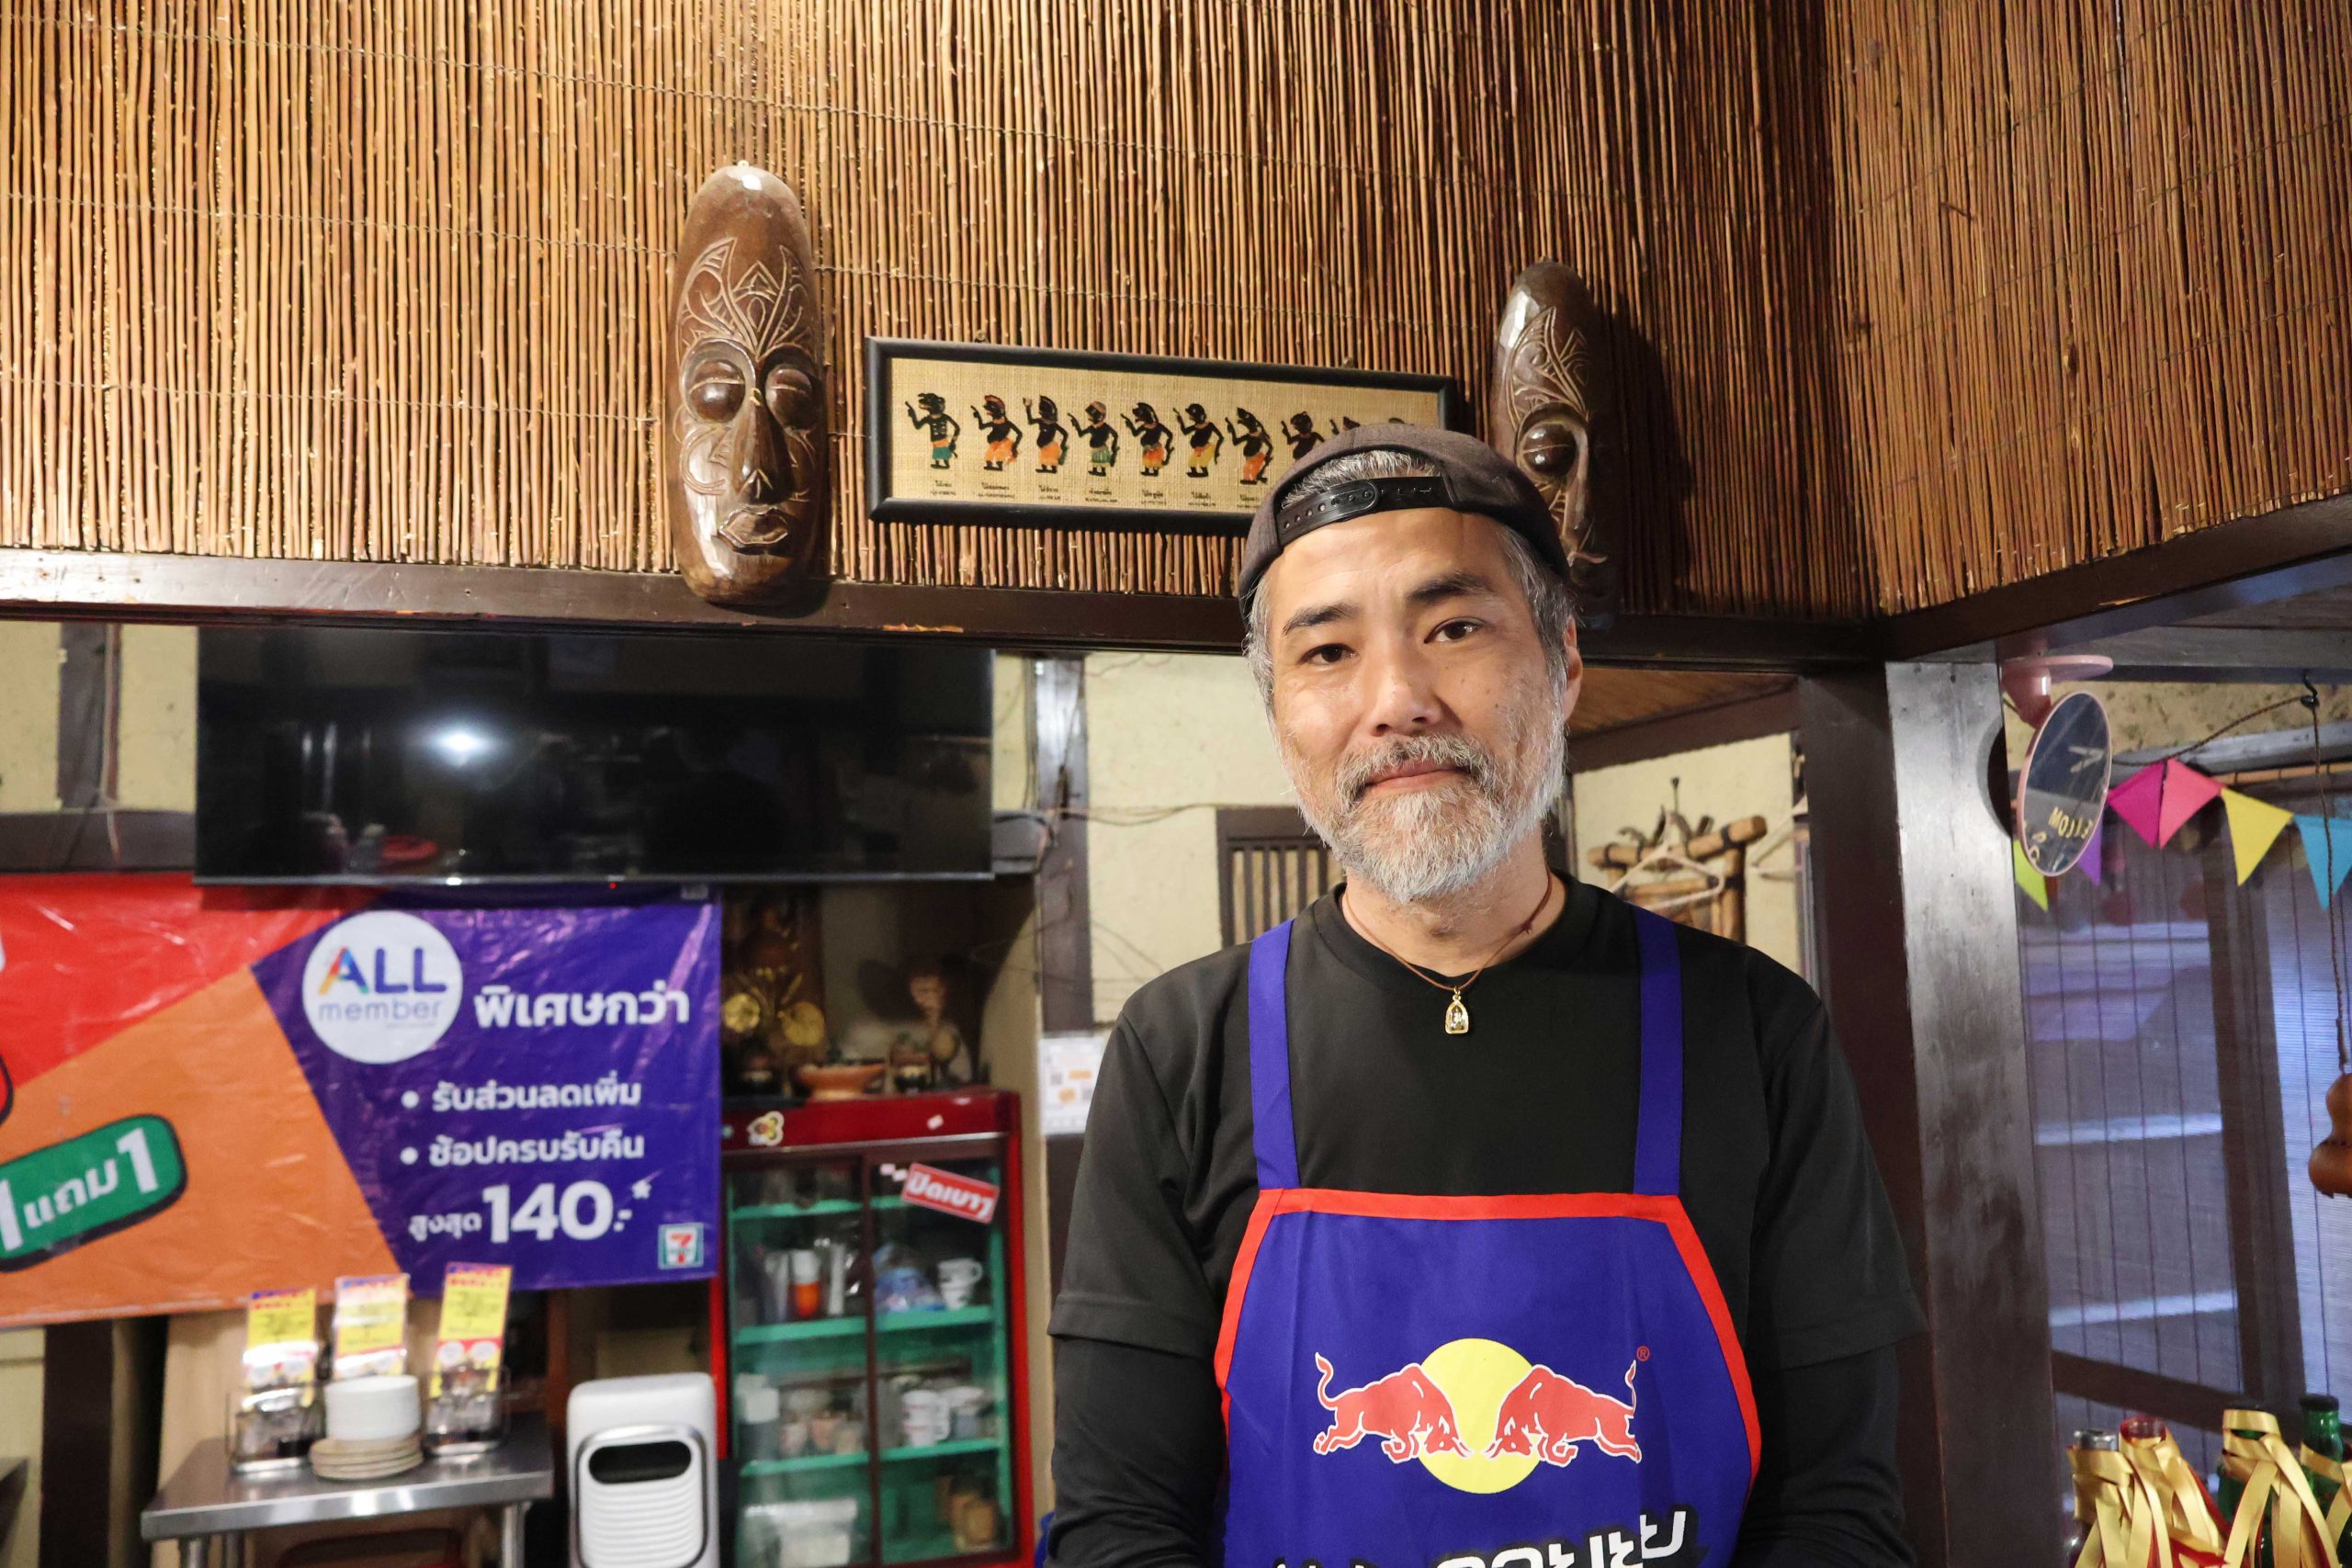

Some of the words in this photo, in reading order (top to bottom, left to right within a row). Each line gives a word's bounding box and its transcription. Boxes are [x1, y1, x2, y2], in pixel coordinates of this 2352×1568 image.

[318, 946, 448, 997] ALL
[318, 999, 442, 1023] member
[473, 979, 690, 1029] พิเศษกว่า
[432, 1069, 642, 1112] รับส่วนลดเพิ่ม
